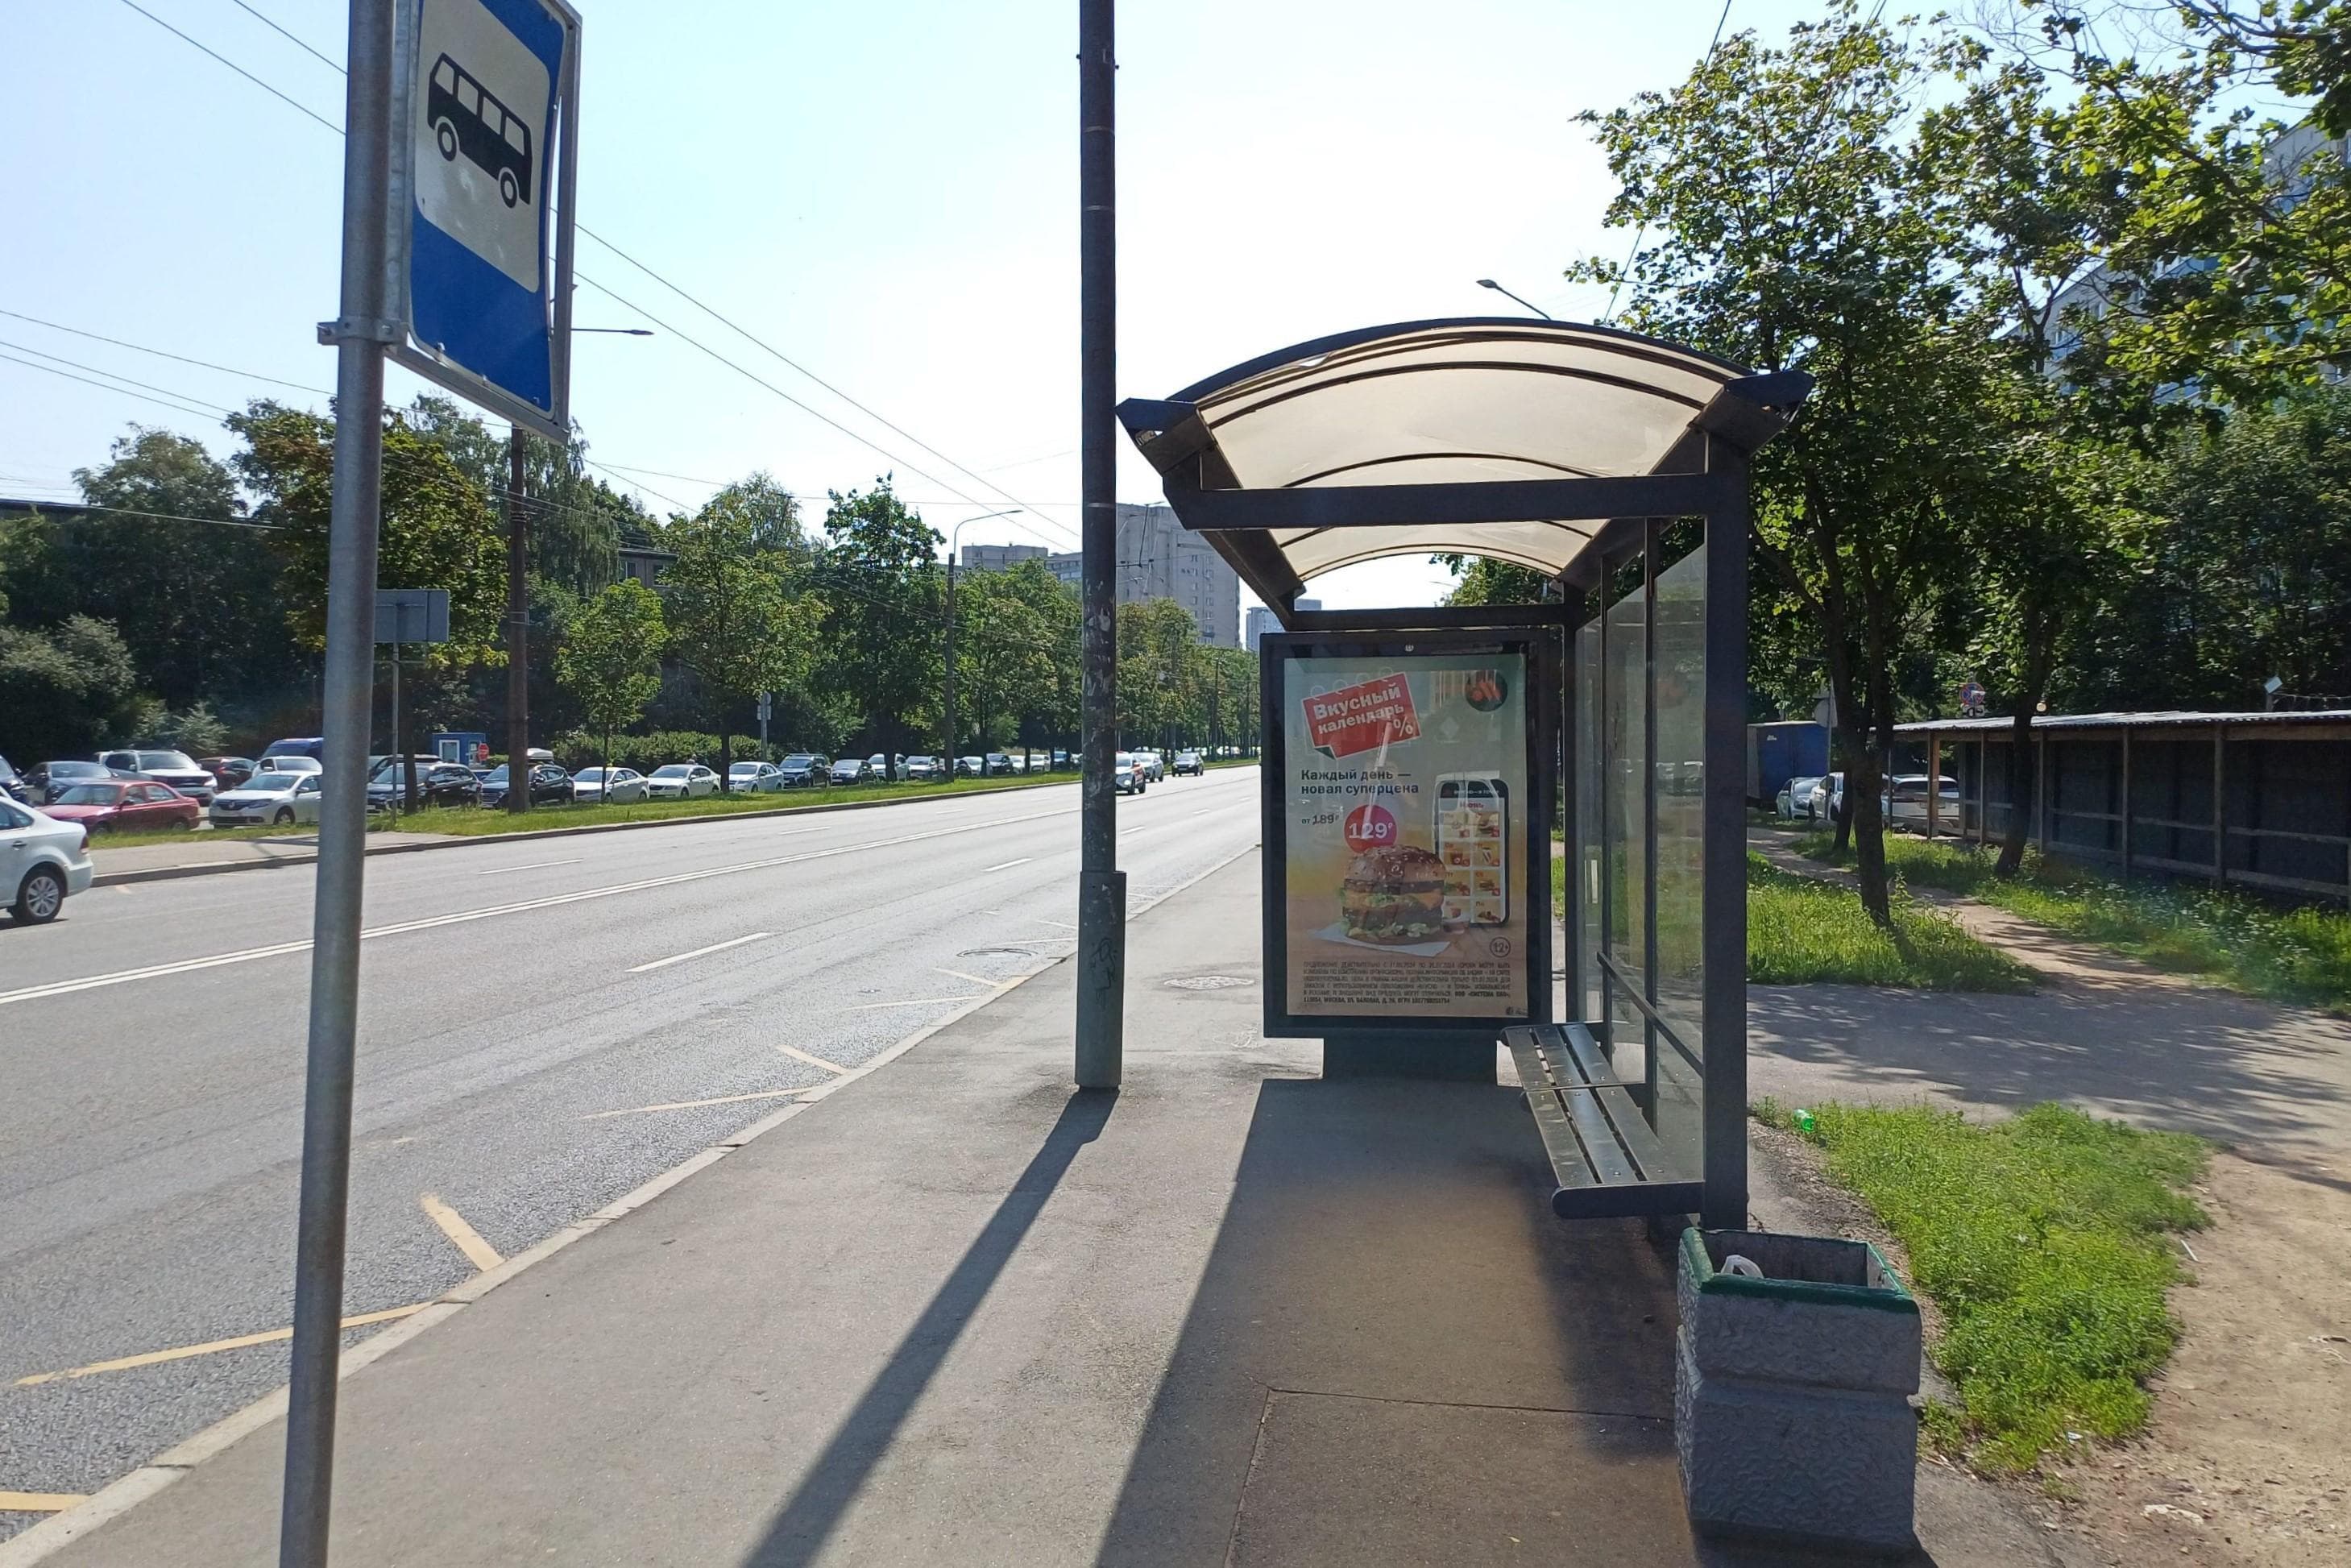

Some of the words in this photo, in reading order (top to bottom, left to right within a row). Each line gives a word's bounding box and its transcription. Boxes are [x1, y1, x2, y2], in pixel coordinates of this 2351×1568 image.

[1313, 682, 1401, 720] Вкусный
[1318, 704, 1404, 734] календарь
[1393, 716, 1414, 737] %
[1301, 769, 1357, 782] Каждый
[1361, 770, 1393, 782] день
[1301, 786, 1341, 794] новая
[1346, 785, 1419, 795] суперцена
